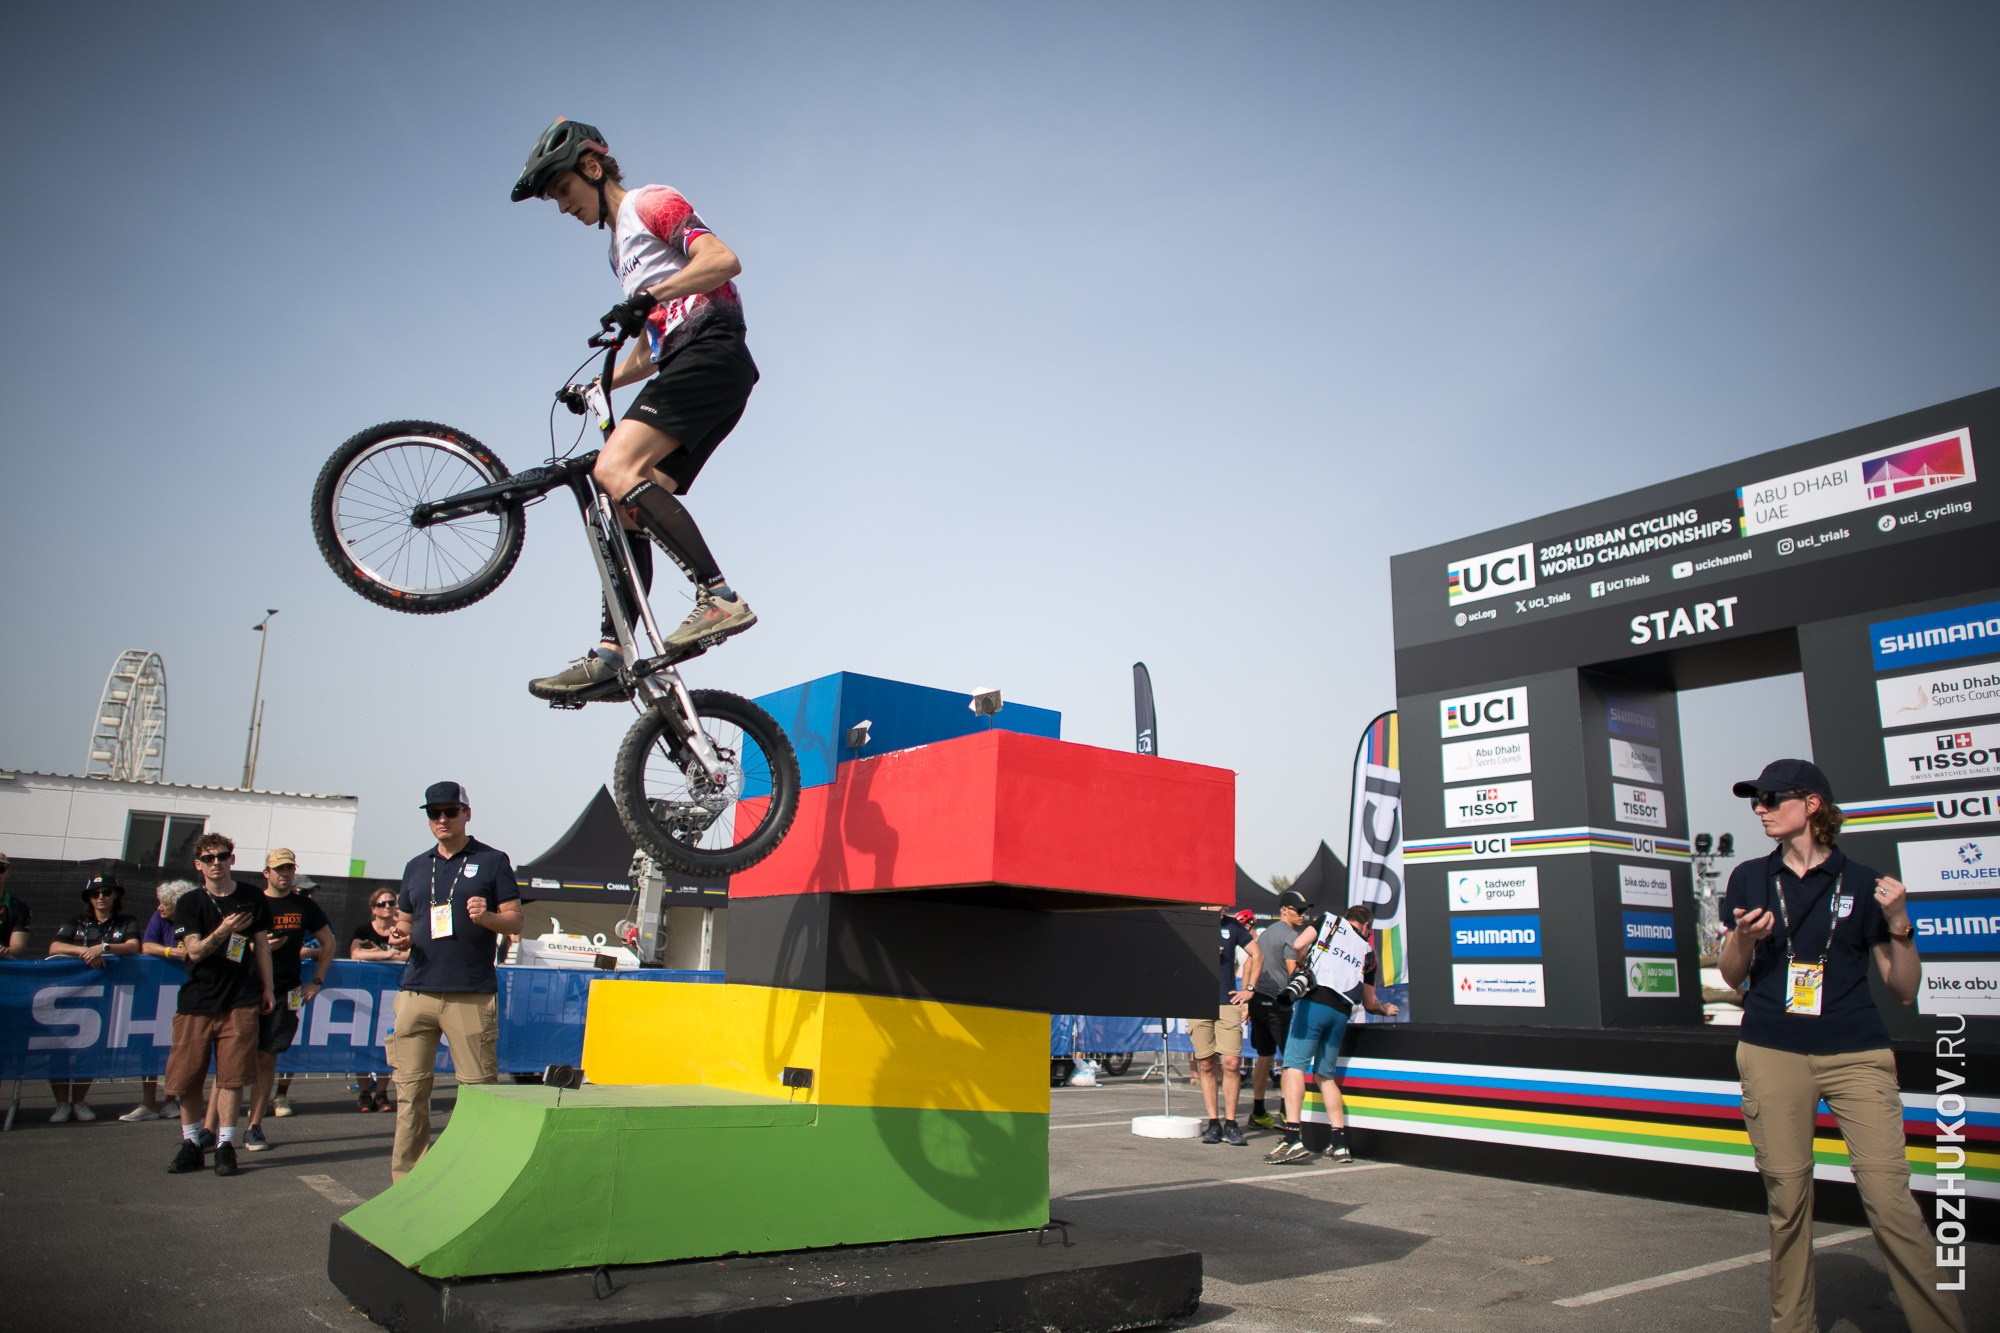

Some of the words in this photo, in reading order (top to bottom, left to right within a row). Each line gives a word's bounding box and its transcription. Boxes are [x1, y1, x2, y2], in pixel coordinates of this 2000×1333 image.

[1754, 485, 1787, 506] ABU
[1793, 470, 1848, 496] DHABI
[1755, 504, 1790, 524] UAE
[1899, 501, 1972, 525] uci_cycling
[1540, 544, 1573, 561] 2024
[1575, 527, 1626, 552] URBAN
[1629, 509, 1698, 538] CYCLING
[1797, 528, 1850, 549] uci_trials
[1541, 556, 1594, 577] WORLD
[1597, 518, 1732, 563] CHAMPIONSHIPS
[1695, 550, 1752, 572] ucichannel
[1463, 553, 1528, 593] UCI
[1607, 580, 1624, 592] UCI
[1625, 574, 1650, 588] Trials
[1529, 592, 1571, 609] UCI_Trials
[1468, 609, 1497, 622] uci.org
[1631, 597, 1738, 645] START
[1879, 618, 2000, 654] SHIMANO
[1931, 681, 1959, 695] Abu
[1931, 691, 1966, 707] Sports
[1460, 697, 1515, 727] UCI
[1610, 708, 1656, 729] SHIMANO
[1476, 749, 1493, 757] Abu
[1495, 744, 1521, 755] Dhabi
[1909, 747, 2000, 772] TISSOT
[1934, 770, 1968, 778] WATCHES
[1459, 801, 1518, 817] TISSOT
[1623, 802, 1658, 818] TISSOT
[1937, 797, 1991, 819] UCI
[1362, 775, 1401, 920] UCI
[1474, 839, 1507, 854] UCI
[1634, 838, 1653, 854] UCI
[607, 883, 630, 891] CHINA
[1485, 879, 1526, 888] tadweer
[1625, 876, 1638, 886] bike
[1638, 878, 1650, 888] abu
[1651, 879, 1667, 889] dhabi
[1486, 889, 1515, 900] group
[1456, 929, 1536, 944] SHIMANO
[1626, 924, 1672, 939] SHIMANO
[548, 943, 601, 954] GENERAC
[1332, 948, 1361, 968] STAFF
[1648, 968, 1658, 976] ABU
[1659, 968, 1673, 977] DHABI
[1928, 977, 1962, 990] bike
[1965, 977, 1998, 990] abu
